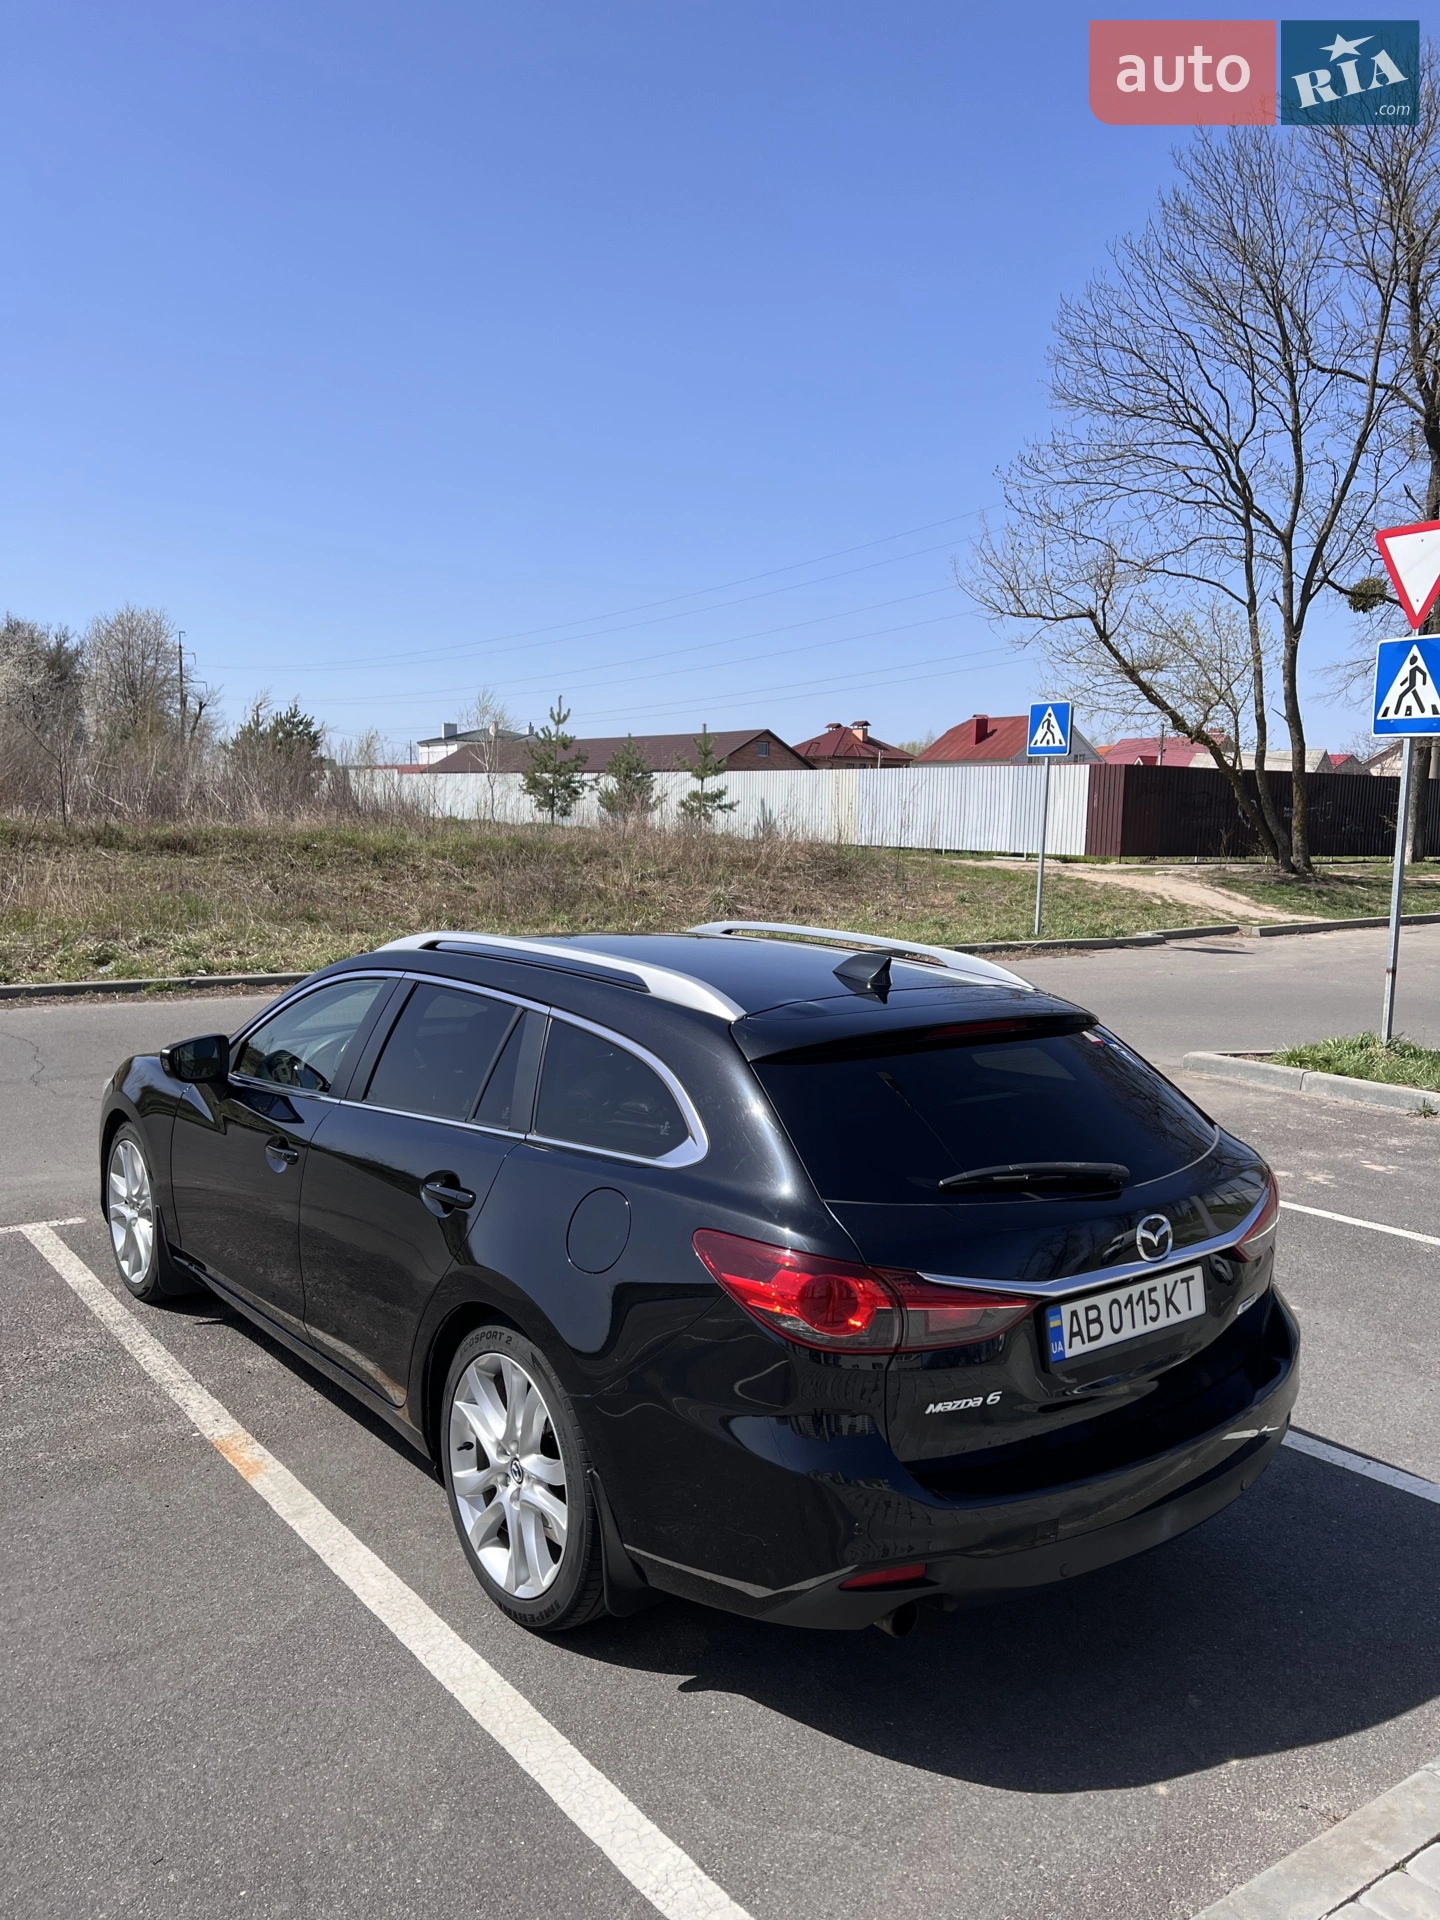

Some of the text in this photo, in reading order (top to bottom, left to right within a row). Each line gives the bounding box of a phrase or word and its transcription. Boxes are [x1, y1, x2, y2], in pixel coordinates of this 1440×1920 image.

[505, 1335, 513, 1346] 2
[1051, 1340, 1064, 1354] UA
[986, 1390, 1003, 1406] 6
